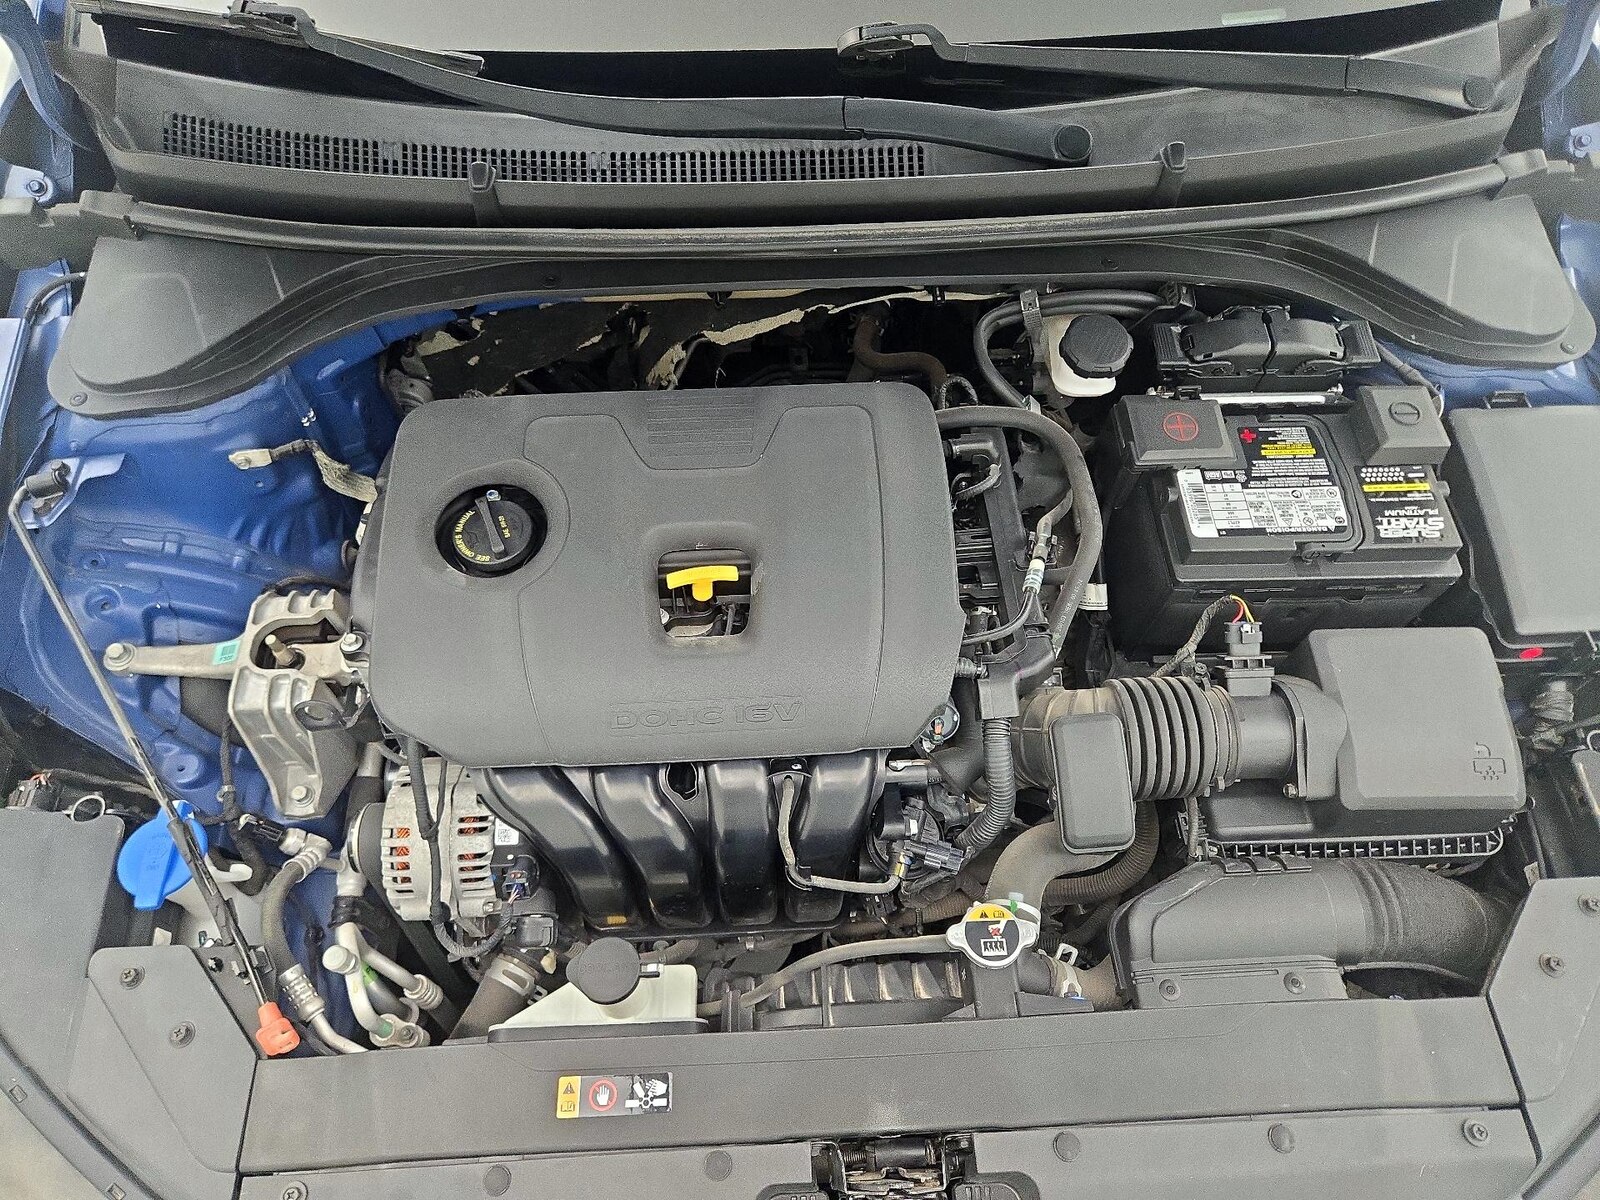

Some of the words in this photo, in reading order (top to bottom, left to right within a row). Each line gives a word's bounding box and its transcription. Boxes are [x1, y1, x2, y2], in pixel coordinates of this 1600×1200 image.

[455, 510, 475, 533] MANUAL
[1384, 508, 1439, 517] PLATINUM
[1376, 516, 1444, 531] START
[1379, 527, 1441, 538] SUPER
[455, 534, 475, 558] OWNER'S
[609, 706, 724, 730] DOHC
[733, 702, 801, 724] 16V
